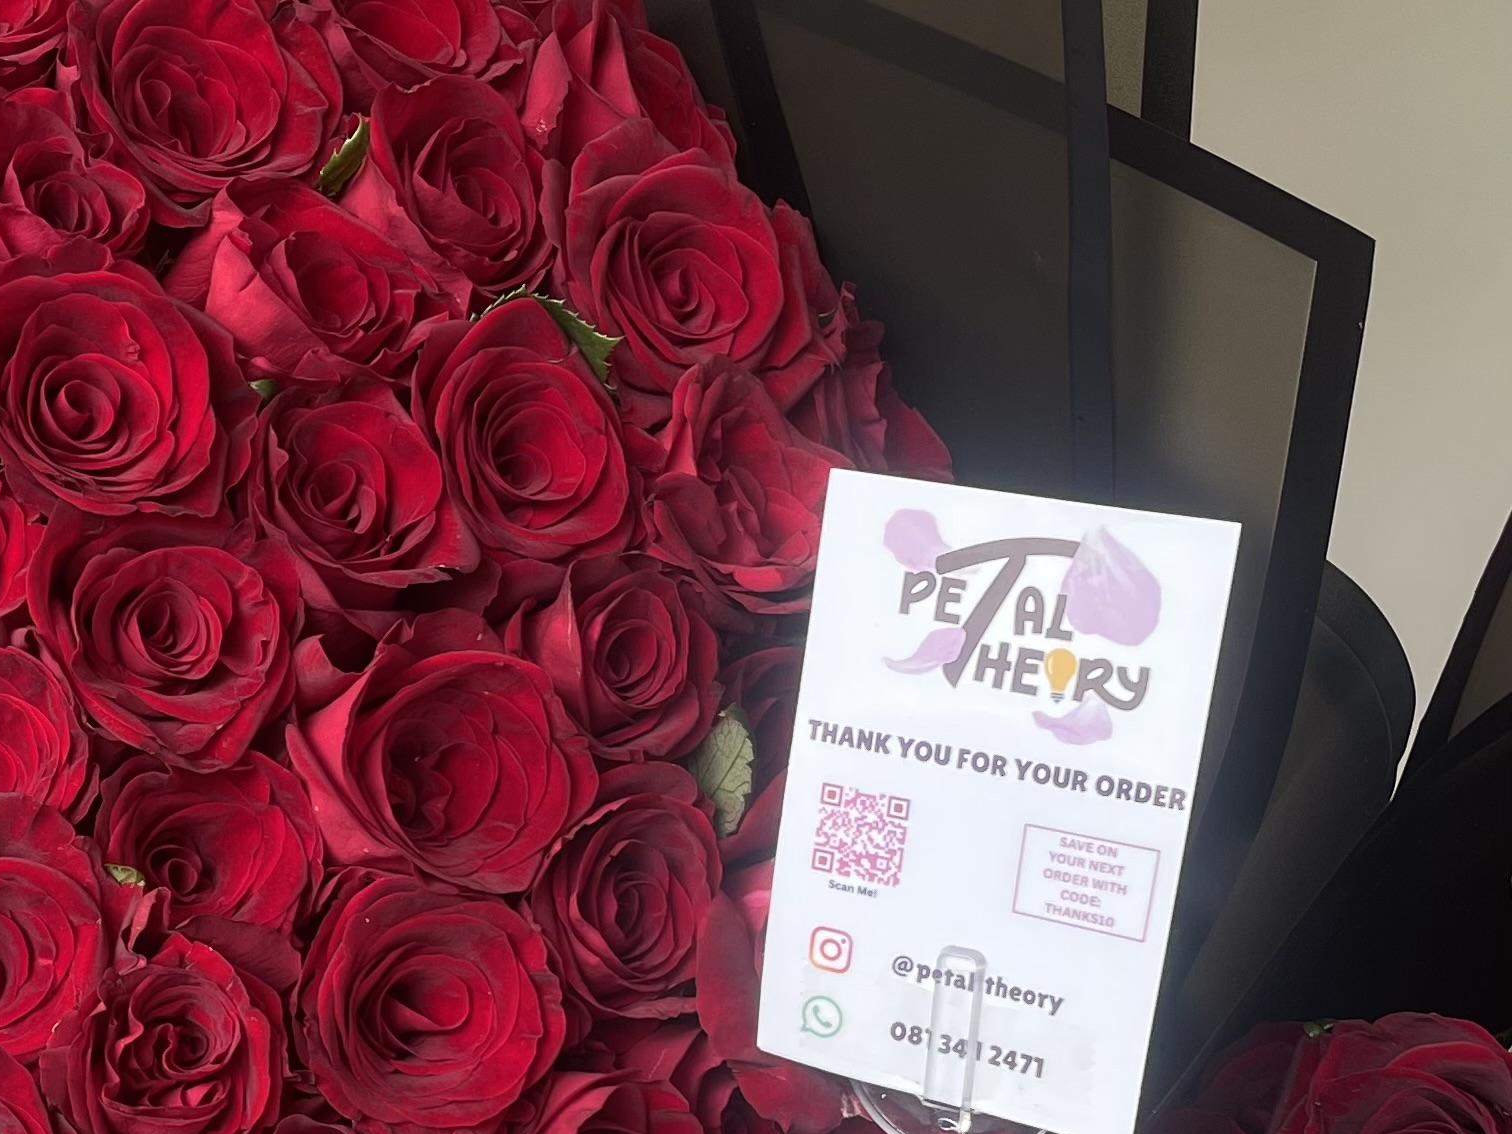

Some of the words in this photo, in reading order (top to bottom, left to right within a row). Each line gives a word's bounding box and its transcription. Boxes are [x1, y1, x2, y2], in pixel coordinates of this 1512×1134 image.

[898, 537, 1082, 643] PETAL
[808, 719, 891, 755] THANK
[897, 736, 952, 766] YOU
[956, 748, 1007, 777] FOR
[1014, 758, 1088, 792] YOUR
[1095, 775, 1187, 811] ORDER
[1059, 837, 1094, 853] SAVE
[1096, 845, 1118, 858] ON
[1049, 851, 1085, 868] YOUR
[1089, 860, 1126, 876] NEXT
[828, 879, 854, 893] Scan
[857, 885, 878, 898] Me!
[1043, 868, 1089, 887] ORDER
[1092, 878, 1128, 896] WITH
[1060, 890, 1102, 908] CODE:
[1045, 902, 1115, 928] THANKS10
[987, 1045, 1045, 1079] 2471
